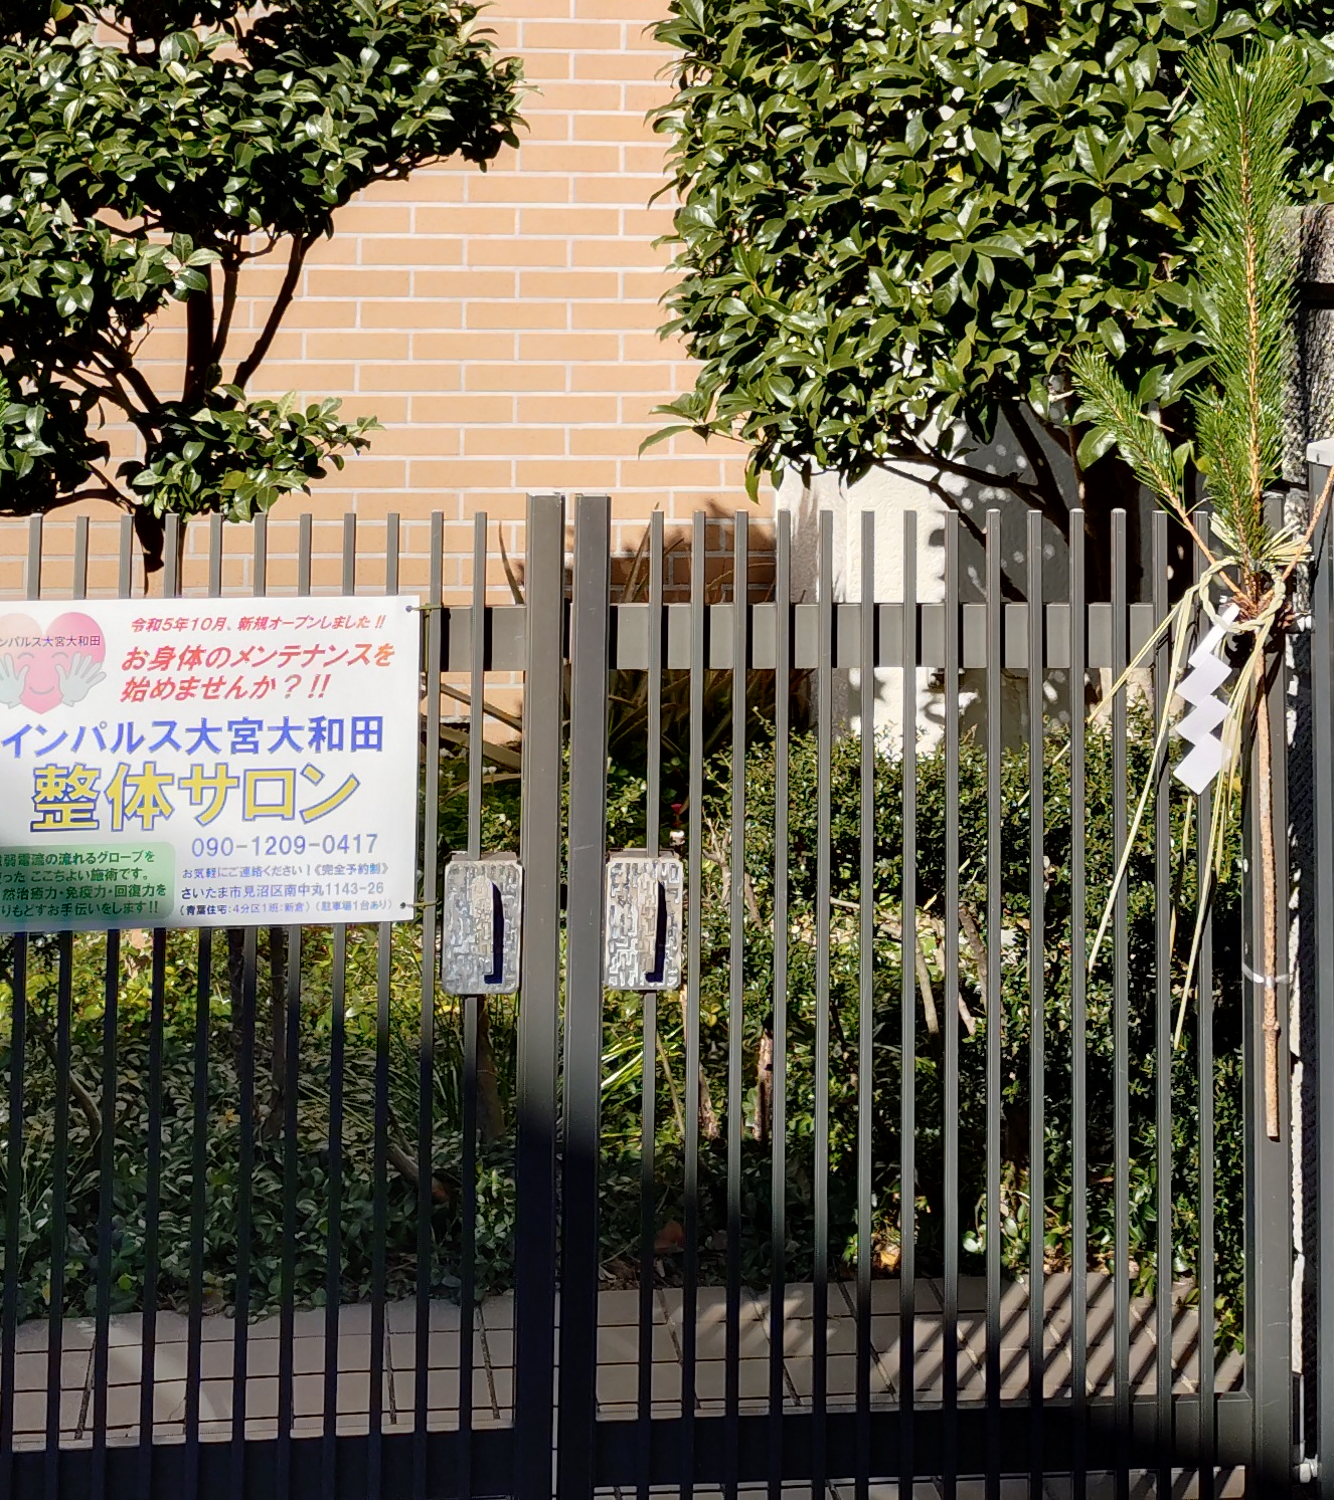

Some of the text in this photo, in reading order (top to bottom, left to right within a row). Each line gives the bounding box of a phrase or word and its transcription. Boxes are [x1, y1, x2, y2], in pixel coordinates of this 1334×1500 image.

[121, 642, 395, 672] お身体のメンテナンスを
[0, 715, 384, 759] インパルス大宮大和田
[30, 761, 361, 833] 整体サロン
[192, 833, 378, 857] 090-1209-0417
[181, 882, 384, 899] さいたま市見沼区南中丸1143-26
